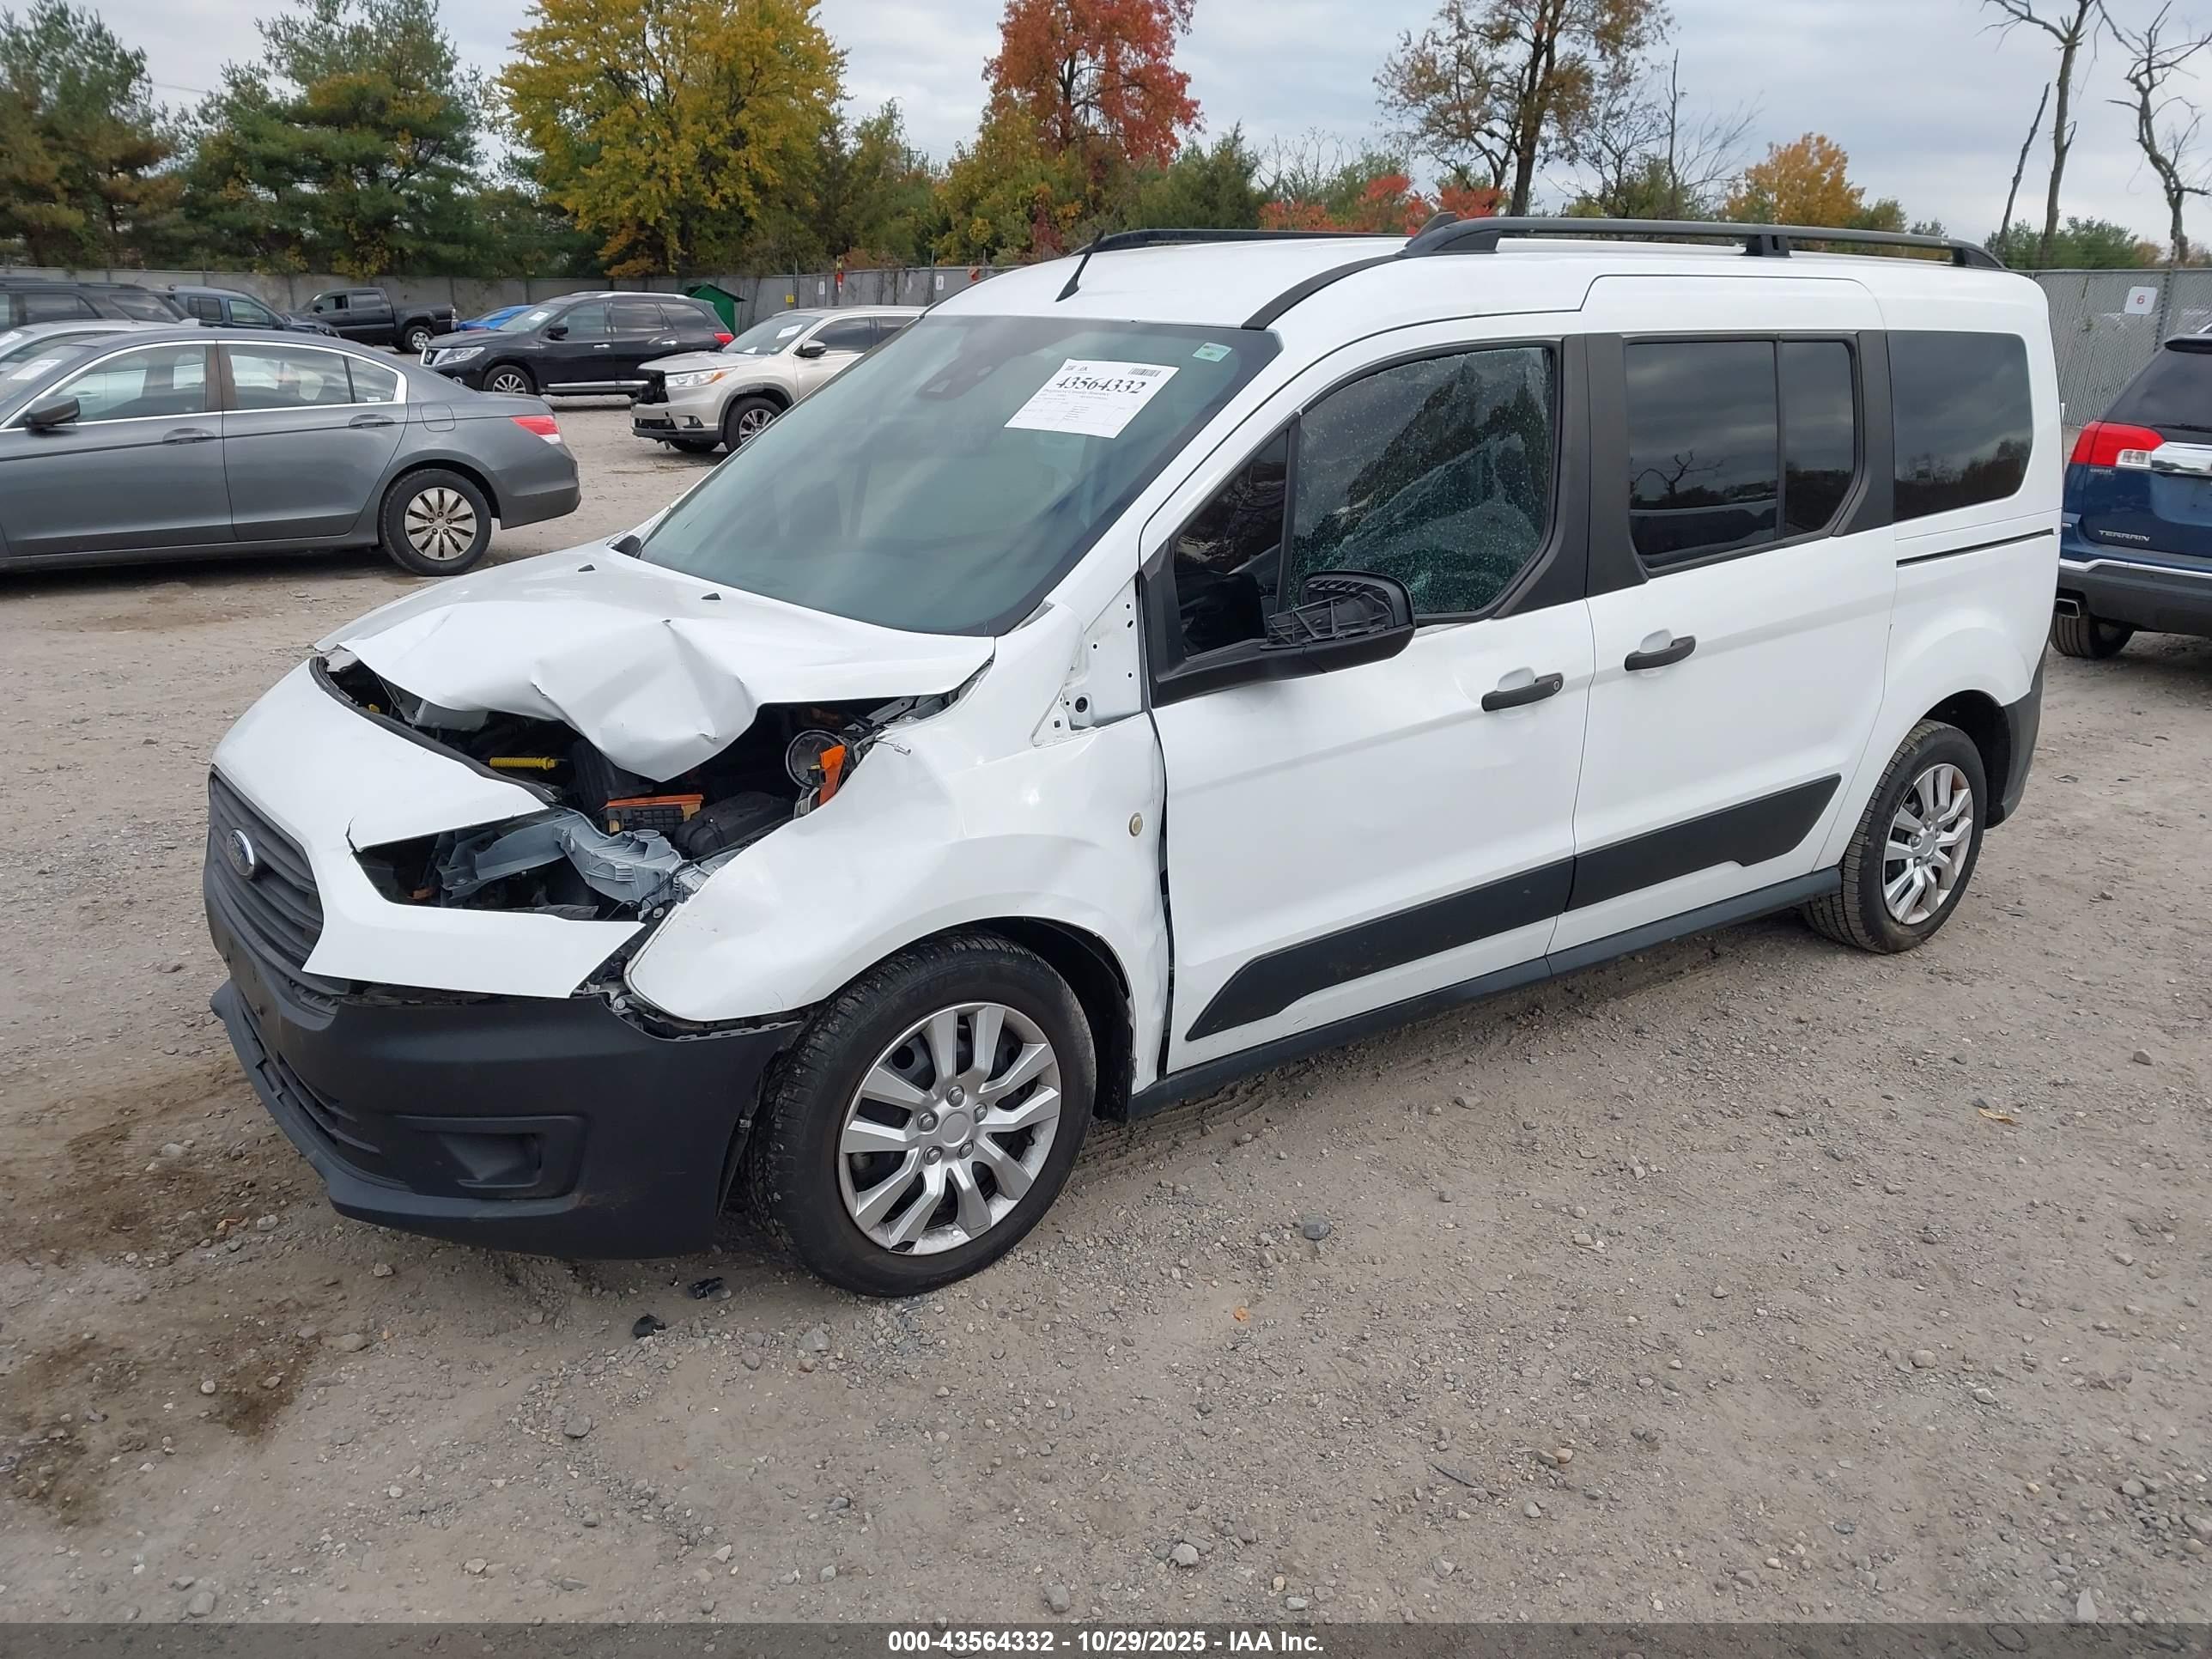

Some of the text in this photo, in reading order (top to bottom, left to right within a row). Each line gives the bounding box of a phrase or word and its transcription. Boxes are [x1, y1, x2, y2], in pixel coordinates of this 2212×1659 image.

[2136, 295, 2145, 305] 6
[1056, 376, 1147, 394] 43564332
[2098, 529, 2150, 542] TERRAIN
